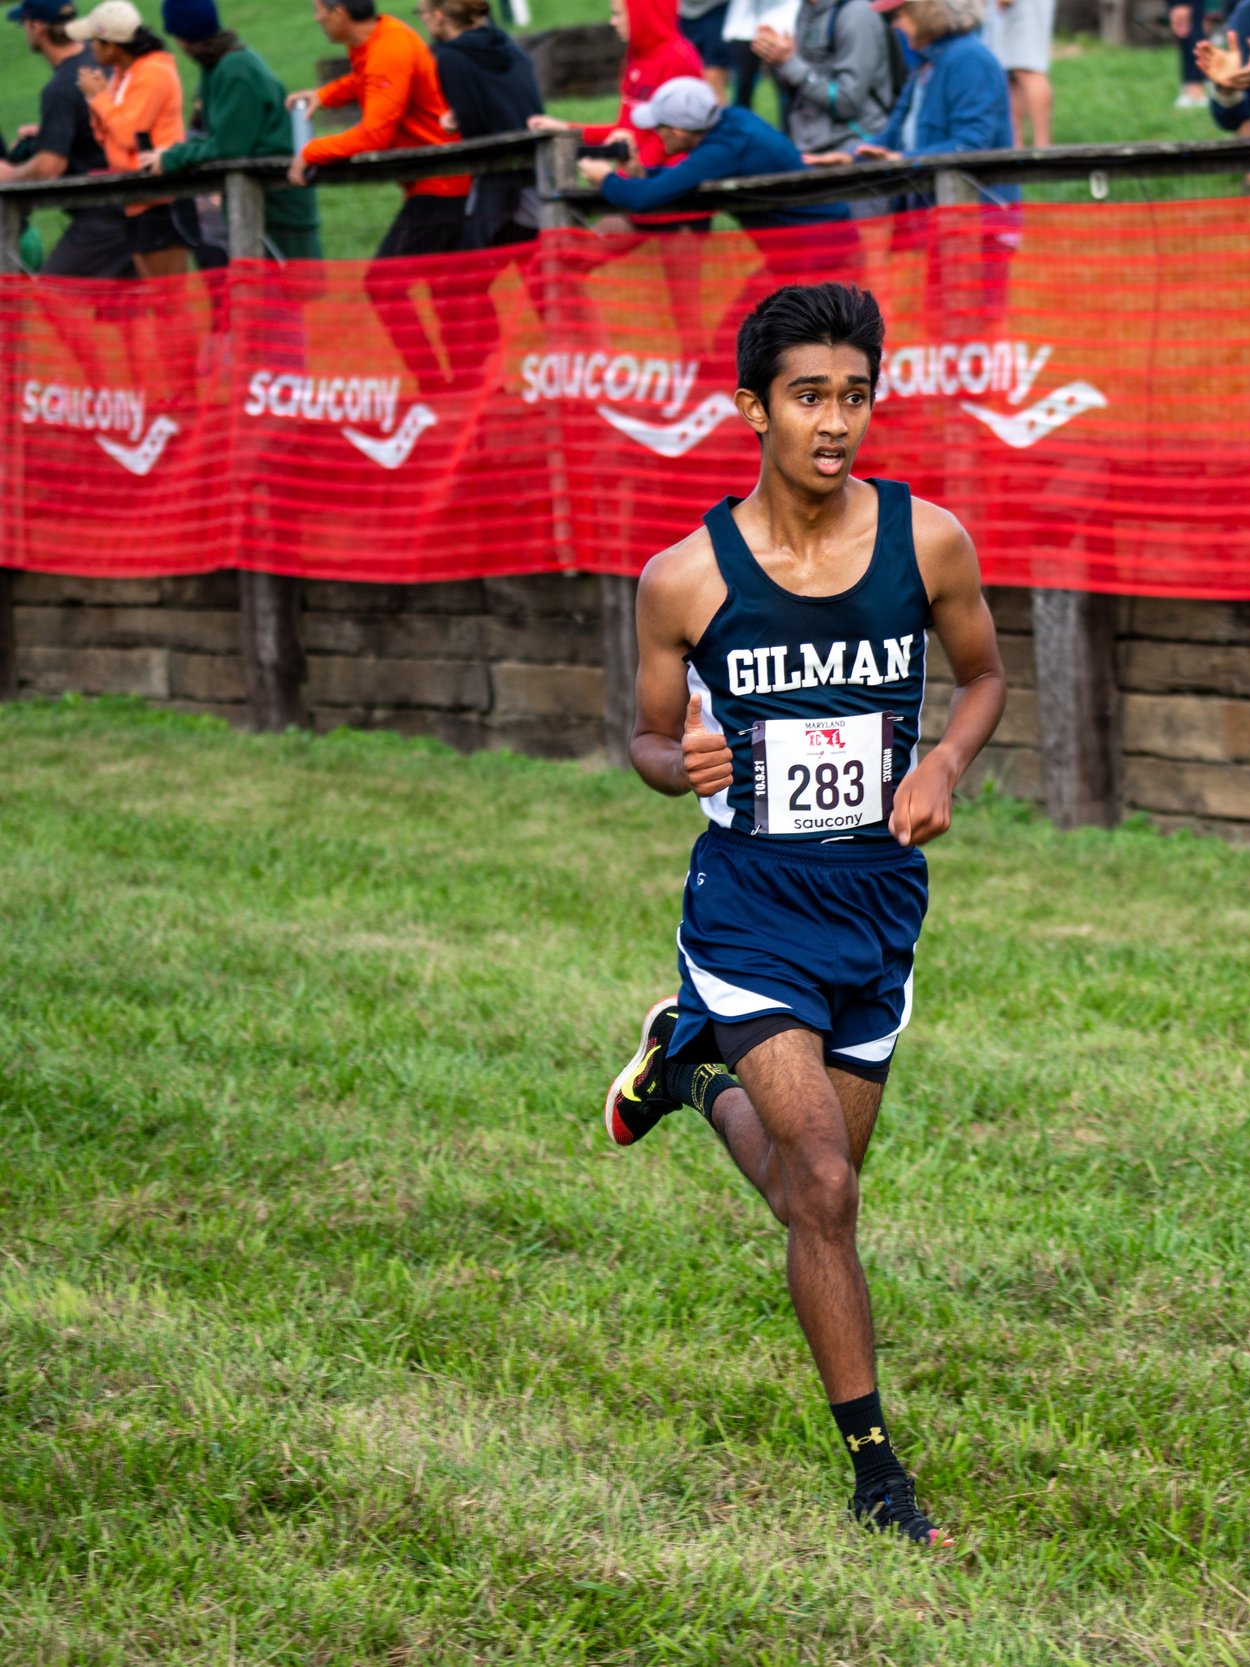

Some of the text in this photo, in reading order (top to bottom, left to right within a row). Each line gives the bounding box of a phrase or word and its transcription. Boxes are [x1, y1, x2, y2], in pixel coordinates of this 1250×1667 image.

[246, 370, 399, 430] saucony
[521, 352, 699, 417] saucony
[22, 379, 146, 440] saucony
[726, 634, 913, 696] GILMAN
[805, 720, 846, 729] MARYLAND
[809, 734, 822, 746] XC
[754, 760, 766, 796] 10.9.21
[787, 760, 864, 811] 283
[882, 748, 893, 782] #MDXC
[793, 813, 863, 830] saucony
